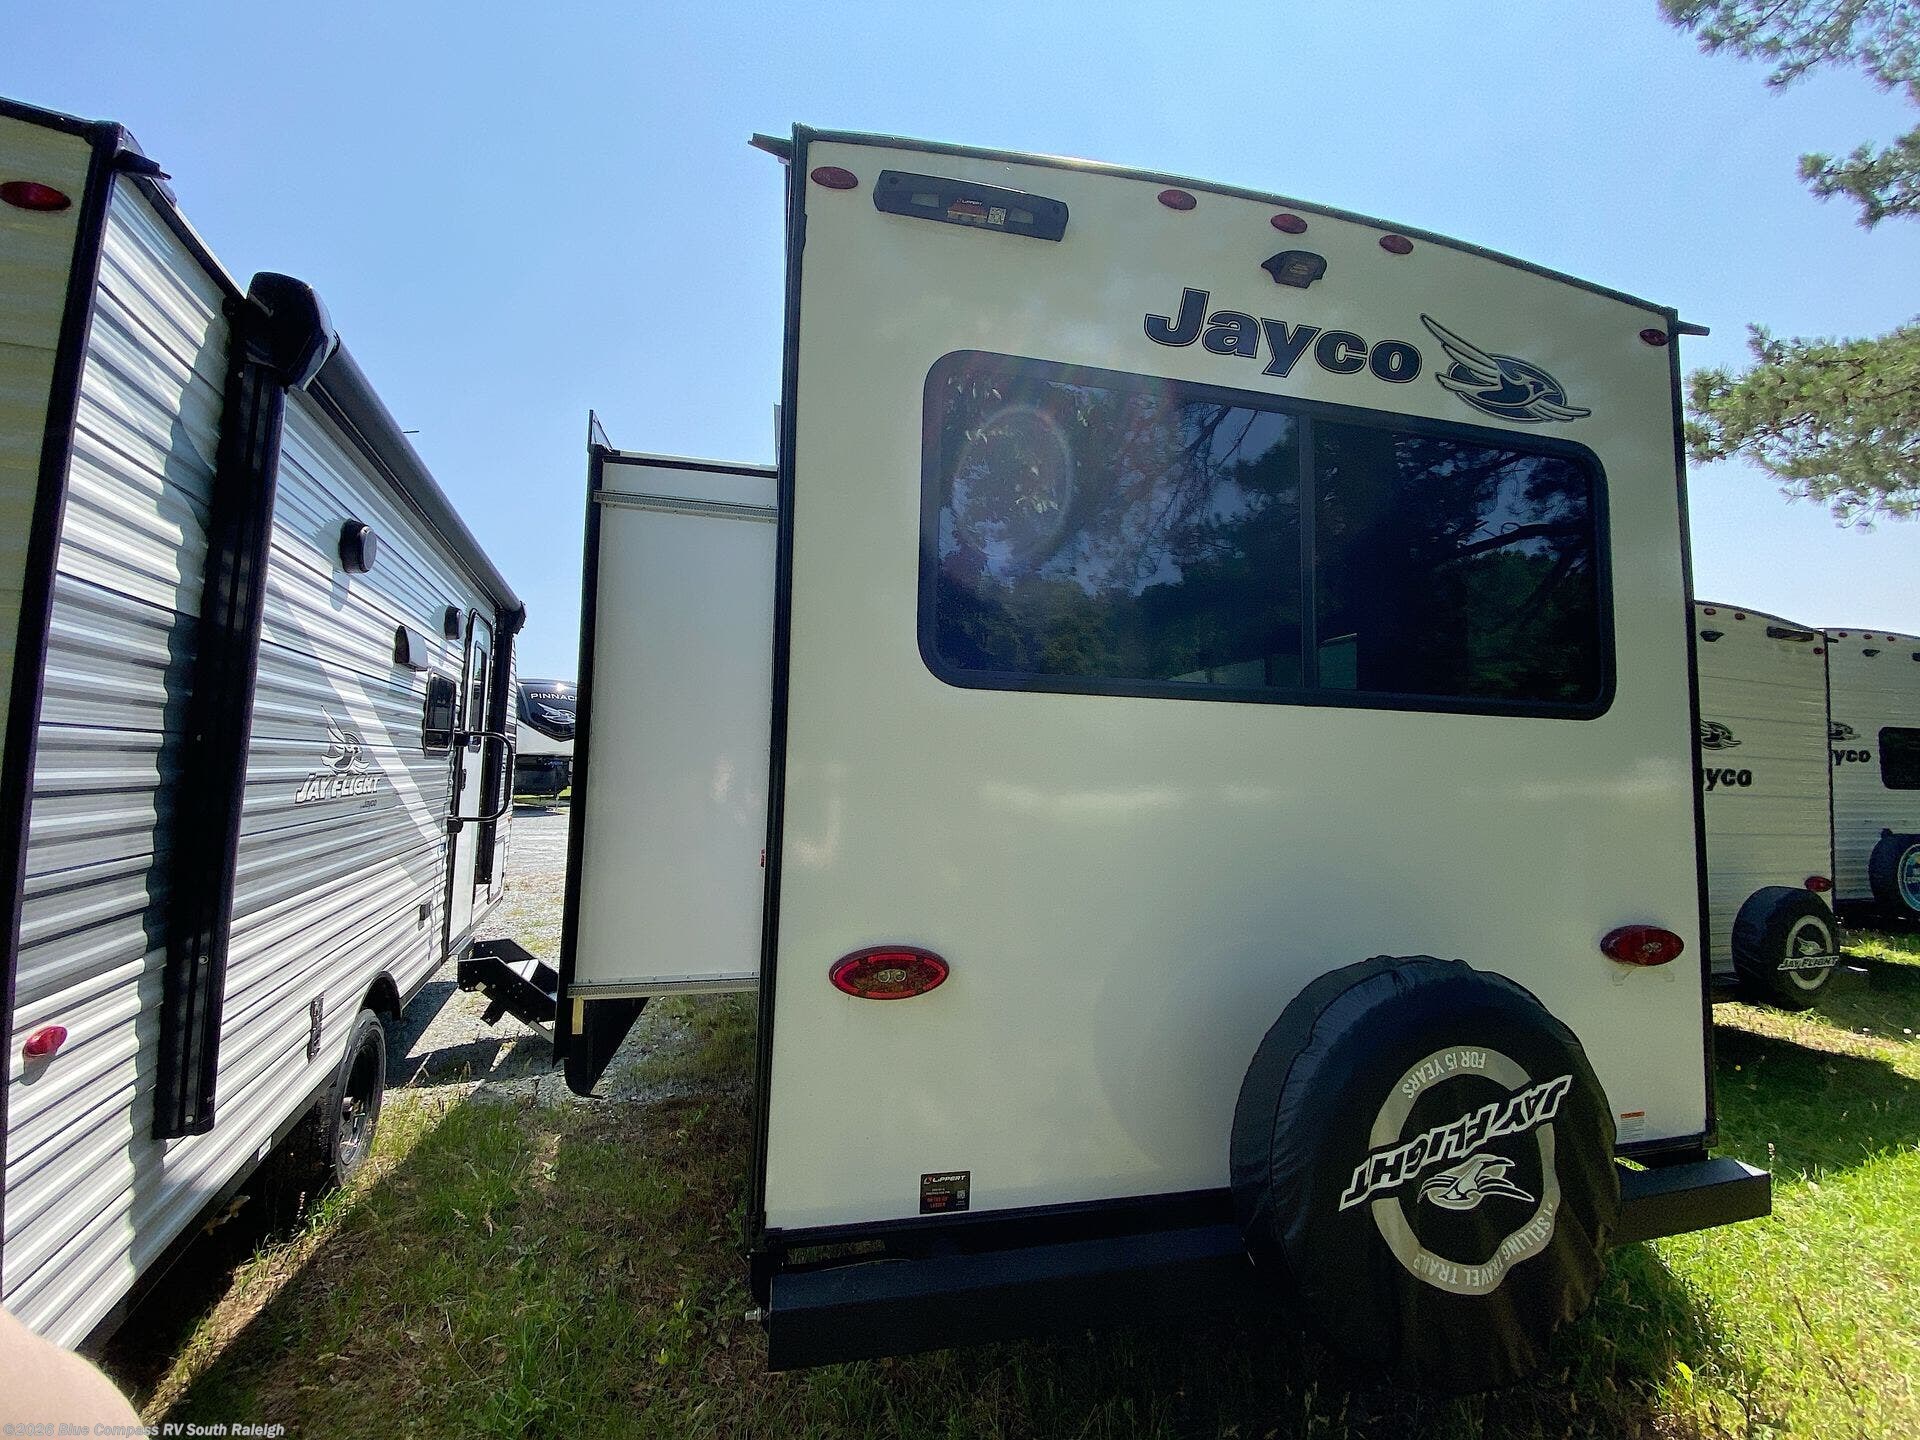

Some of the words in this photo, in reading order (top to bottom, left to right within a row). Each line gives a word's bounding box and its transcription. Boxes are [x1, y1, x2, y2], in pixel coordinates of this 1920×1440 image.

[1144, 287, 1423, 384] Jayco
[530, 693, 577, 701] PINNAC
[1832, 750, 1872, 766] yco
[294, 772, 331, 804] JAY
[330, 772, 381, 798] FLIGHT
[1702, 768, 1752, 791] yco
[1445, 1052, 1459, 1071] 15
[1460, 1051, 1487, 1069] FOR
[1401, 1058, 1445, 1100] YEARS
[1491, 1074, 1573, 1137] JAY
[1338, 1102, 1500, 1212] FLIGHT
[932, 1174, 966, 1183] LIPPERT
[1501, 1217, 1552, 1261] SELLING
[1464, 1254, 1504, 1287] TRAVEL
